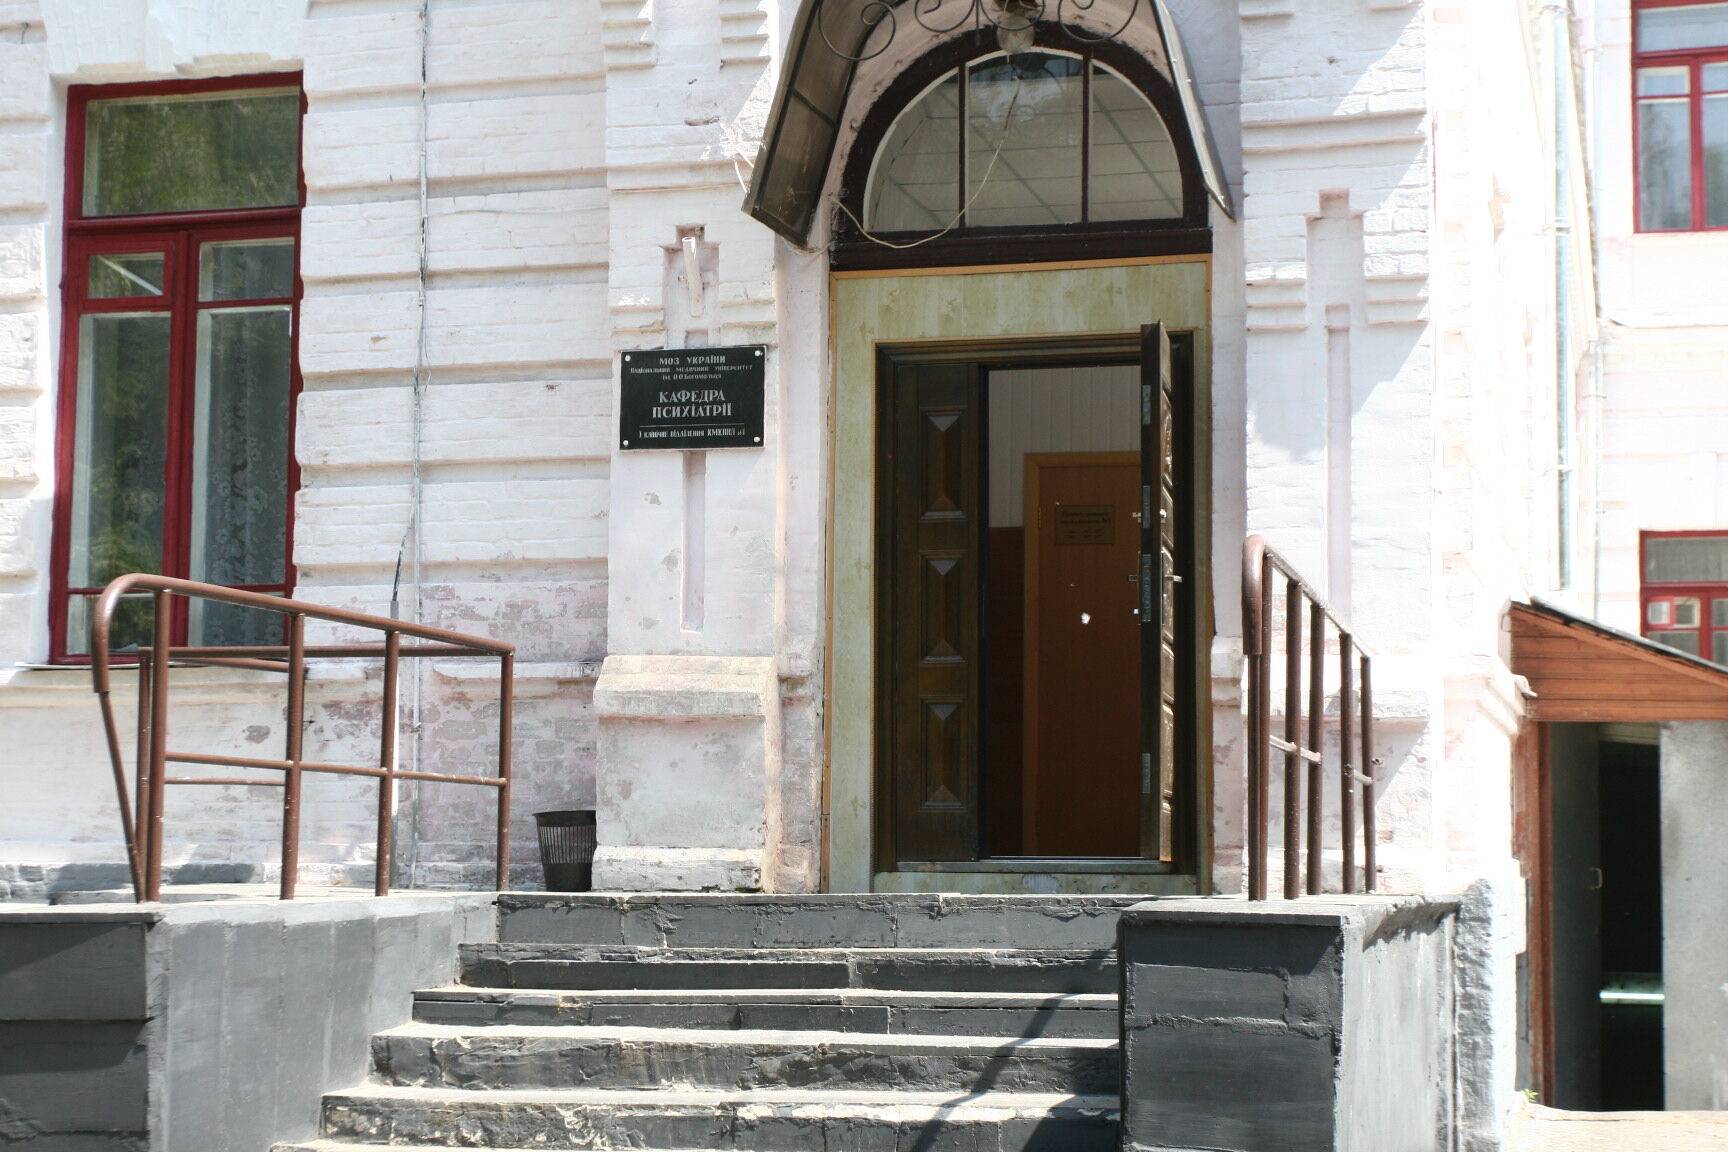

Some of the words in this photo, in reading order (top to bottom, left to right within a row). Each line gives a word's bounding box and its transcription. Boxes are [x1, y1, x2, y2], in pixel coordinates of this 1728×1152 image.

[659, 357, 680, 366] МОЗ
[686, 355, 726, 365] УКРАЇНИ
[659, 389, 726, 403] КАФЕДРА
[652, 403, 732, 418] ПСИХІАТРІЇ
